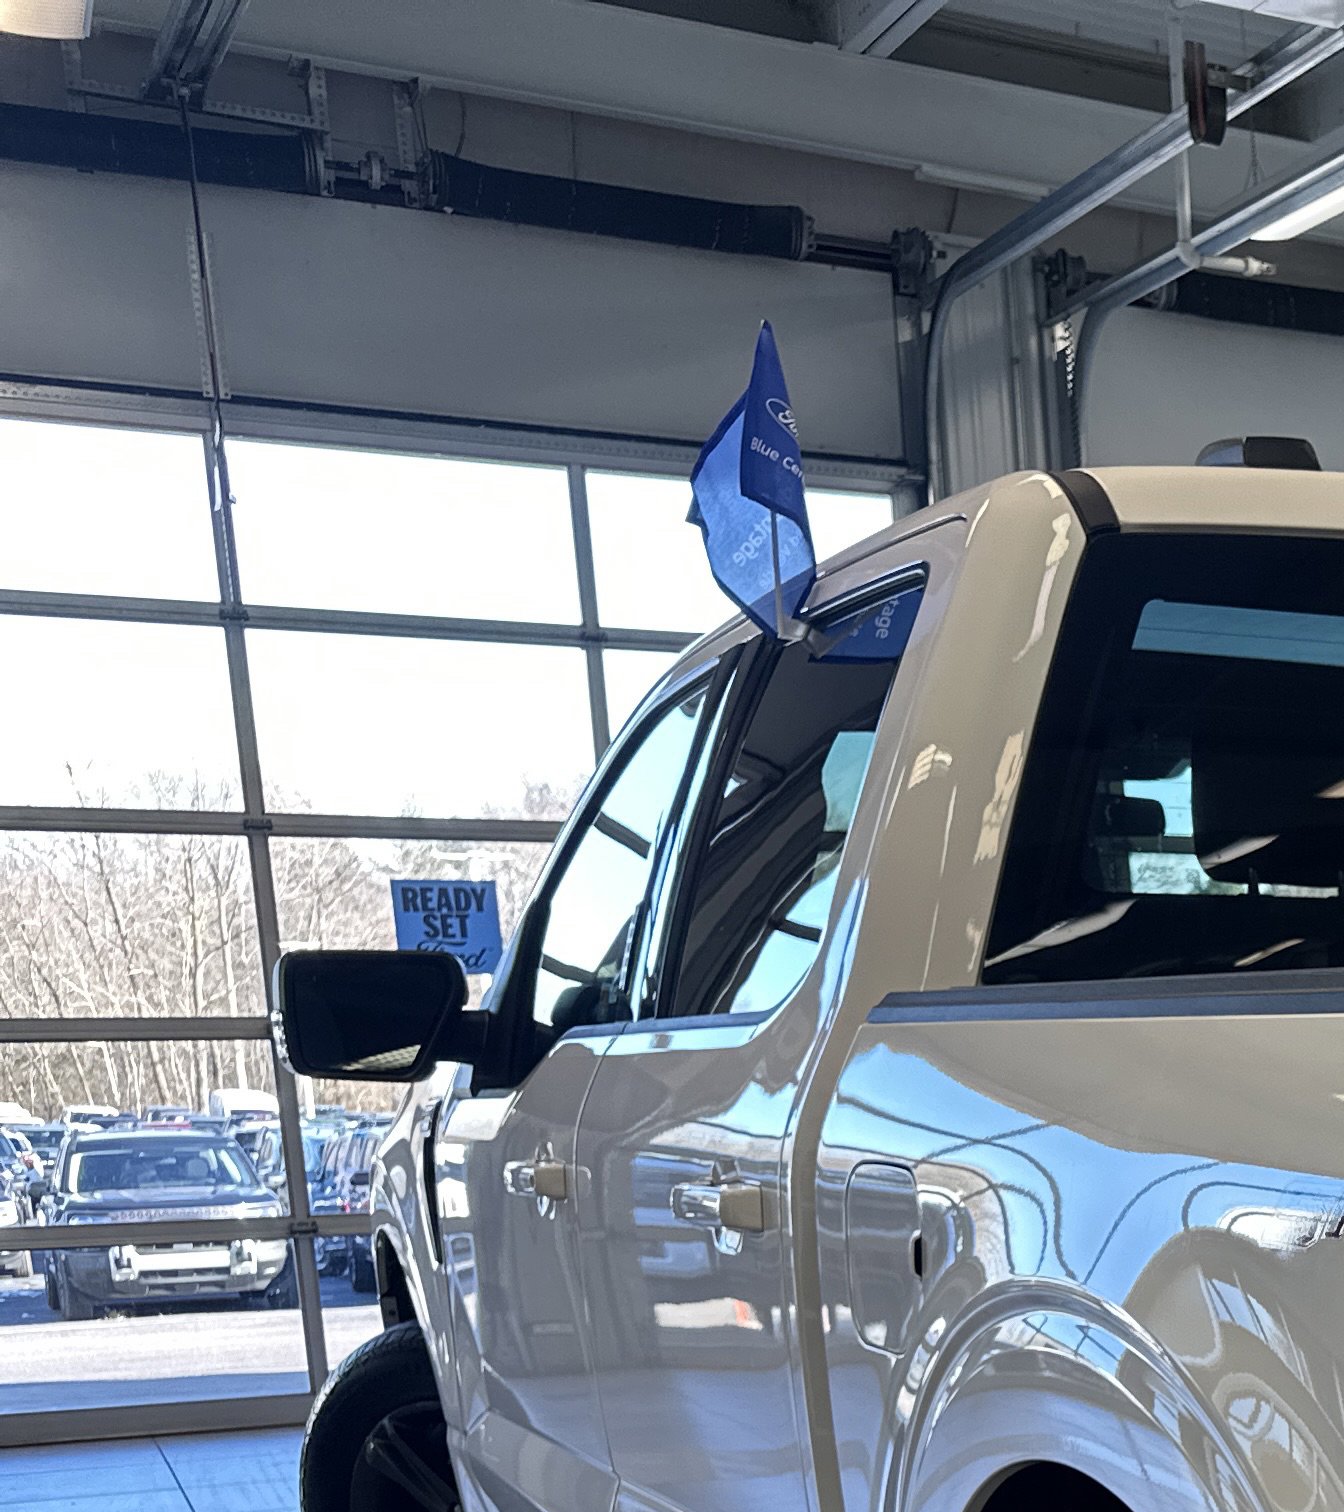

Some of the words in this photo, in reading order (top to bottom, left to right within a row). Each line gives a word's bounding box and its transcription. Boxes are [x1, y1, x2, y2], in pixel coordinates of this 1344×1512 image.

[749, 436, 780, 462] Blue
[401, 886, 488, 913] READY
[422, 913, 470, 939] SET
